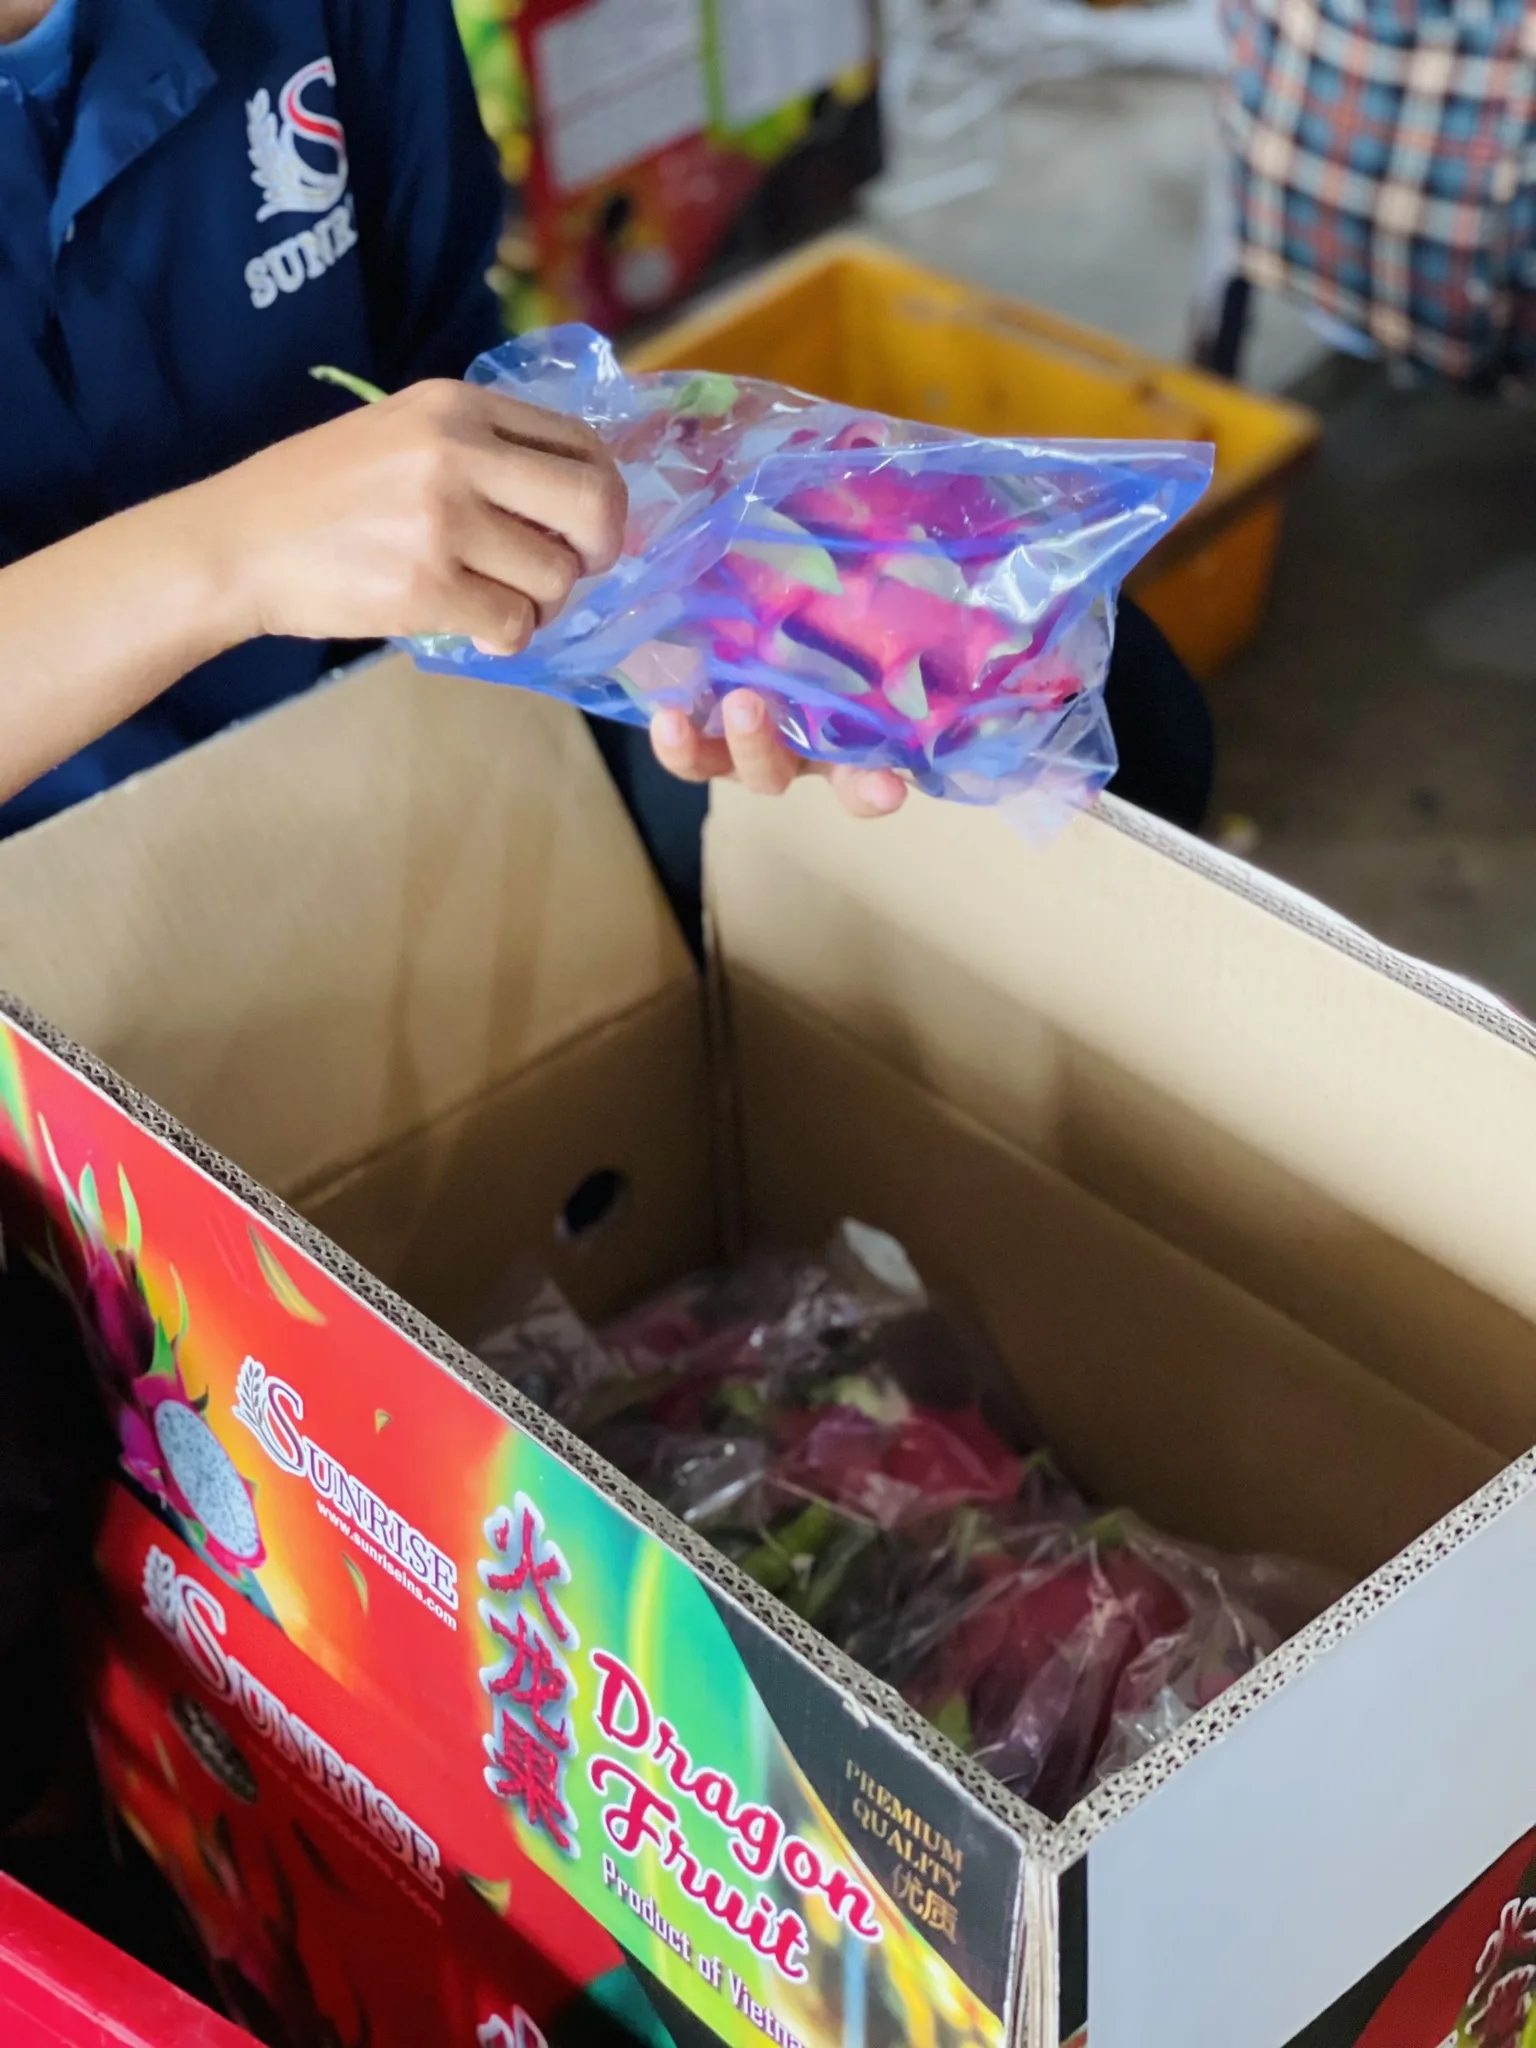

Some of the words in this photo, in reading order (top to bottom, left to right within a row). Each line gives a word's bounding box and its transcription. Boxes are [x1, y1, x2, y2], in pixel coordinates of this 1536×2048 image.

[244, 204, 358, 309] SUNR
[316, 1499, 457, 1632] www.sunriseins.com
[479, 1494, 578, 1856] 火龙果
[591, 1650, 882, 1941] Dragon
[845, 1759, 965, 1873] PREMIUM
[852, 1796, 962, 1897] QUALITY
[589, 1757, 808, 1983] Fruit
[602, 1852, 692, 1964] Product
[698, 1952, 724, 1989] of
[889, 1863, 959, 1945] 优质
